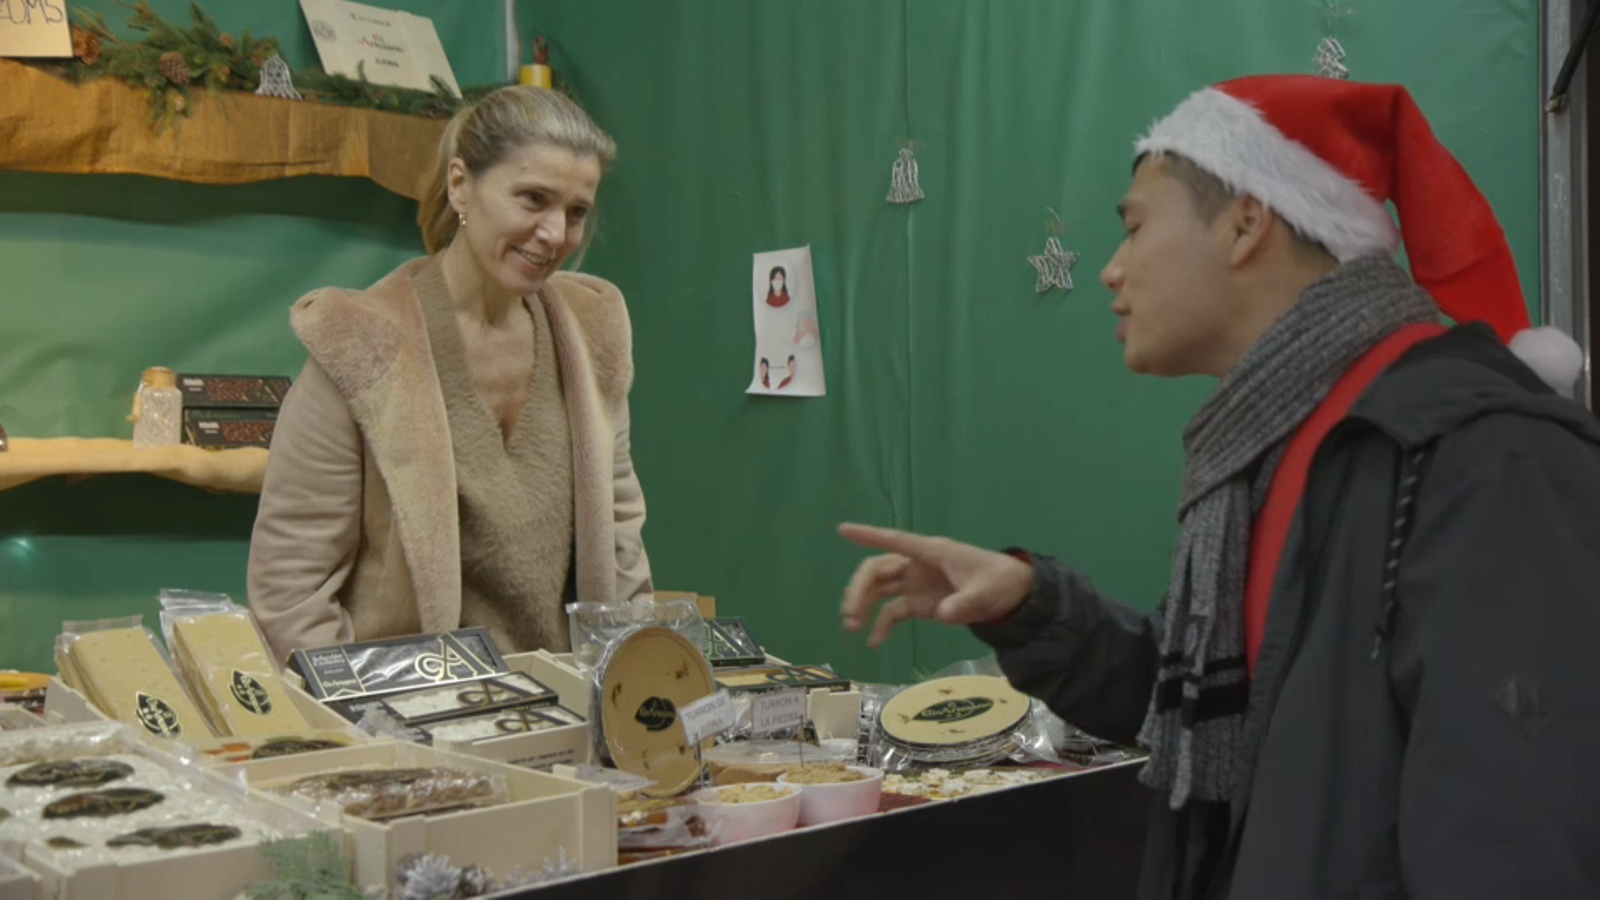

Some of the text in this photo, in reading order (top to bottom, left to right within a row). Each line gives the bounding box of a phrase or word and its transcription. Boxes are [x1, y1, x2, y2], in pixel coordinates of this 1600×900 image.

[686, 702, 716, 720] TURRON
[716, 695, 727, 707] DE
[760, 694, 800, 710] TURRON A
[761, 716, 771, 727] LA
